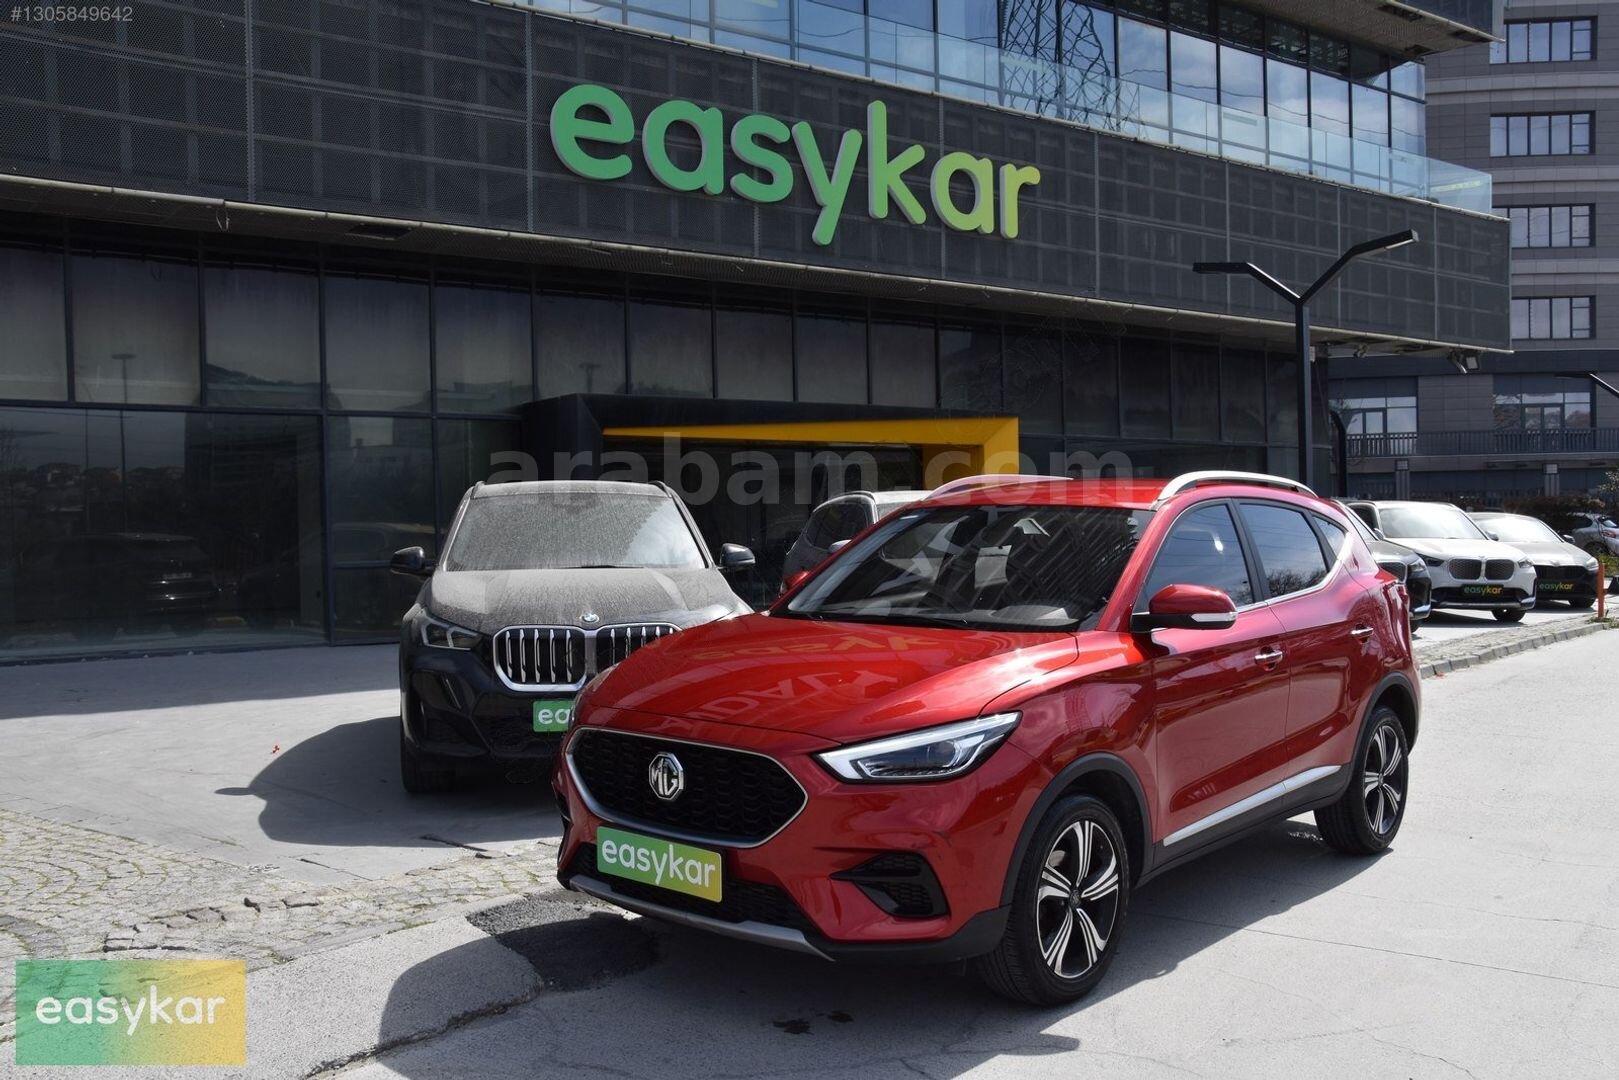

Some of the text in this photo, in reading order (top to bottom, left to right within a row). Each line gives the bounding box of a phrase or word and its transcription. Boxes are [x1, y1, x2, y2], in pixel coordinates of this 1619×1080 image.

[550, 84, 1040, 245] easykar
[1464, 586, 1503, 596] easykar
[1539, 582, 1574, 592] easykar
[650, 756, 680, 797] MG
[602, 840, 716, 887] easykar
